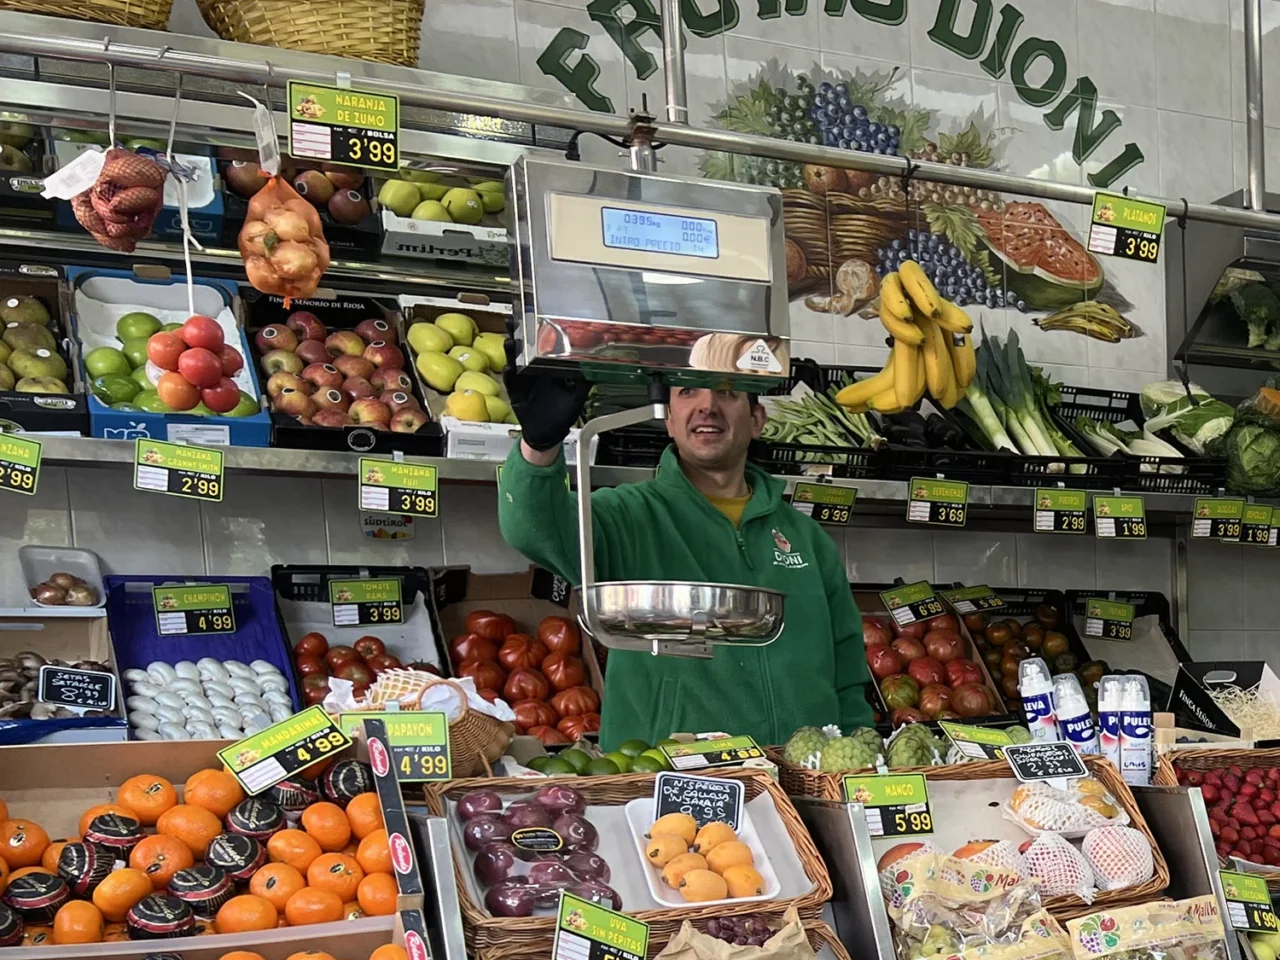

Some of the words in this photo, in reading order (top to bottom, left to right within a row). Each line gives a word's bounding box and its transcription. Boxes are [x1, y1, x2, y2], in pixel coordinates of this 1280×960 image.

[927, 0, 1145, 188] DIONI
[335, 94, 386, 111] NARANJA
[337, 110, 351, 122] DE
[354, 112, 385, 126] ZUMO
[367, 130, 394, 139] BOLSA
[349, 138, 395, 164] 3'99
[1123, 207, 1157, 225] PLATANOS
[1126, 238, 1158, 260] 3'99
[343, 302, 365, 310] RIOJA
[176, 449, 212, 461] MANZANA
[167, 456, 197, 469] GRANNY
[198, 461, 219, 473] SMITH
[391, 466, 431, 477] MANZANA
[182, 477, 219, 496] 2'99
[403, 478, 418, 486] FUJI
[932, 486, 964, 498] BERENJENAS
[401, 495, 435, 513] 3'99
[821, 509, 849, 522] 9'99
[938, 507, 964, 523] 3'69
[1062, 516, 1085, 530] 2'99
[1123, 522, 1145, 535] 1'99
[1217, 524, 1240, 536] 3'99
[1247, 529, 1269, 542] 1'99
[370, 607, 400, 621] 3'99
[919, 601, 942, 616] 6'99
[199, 615, 232, 630] 4'99
[1110, 625, 1131, 638] 3'99
[56, 672, 91, 683] SETAS
[1179, 690, 1196, 710] FINCA
[1067, 719, 1093, 733] PULEV
[1124, 716, 1150, 727] PULEV
[260, 714, 325, 749] MANDARINAS
[311, 728, 331, 740] KILO
[388, 722, 433, 737] PAPAYON
[296, 732, 345, 761] 4'99
[400, 755, 448, 775] 4'99
[885, 784, 914, 796] MANGO
[896, 812, 931, 832] 5'99
[610, 917, 627, 932] UVA
[1253, 911, 1277, 928] 4'99
[592, 925, 605, 938] SIN
[608, 931, 641, 952] PEPITAS
